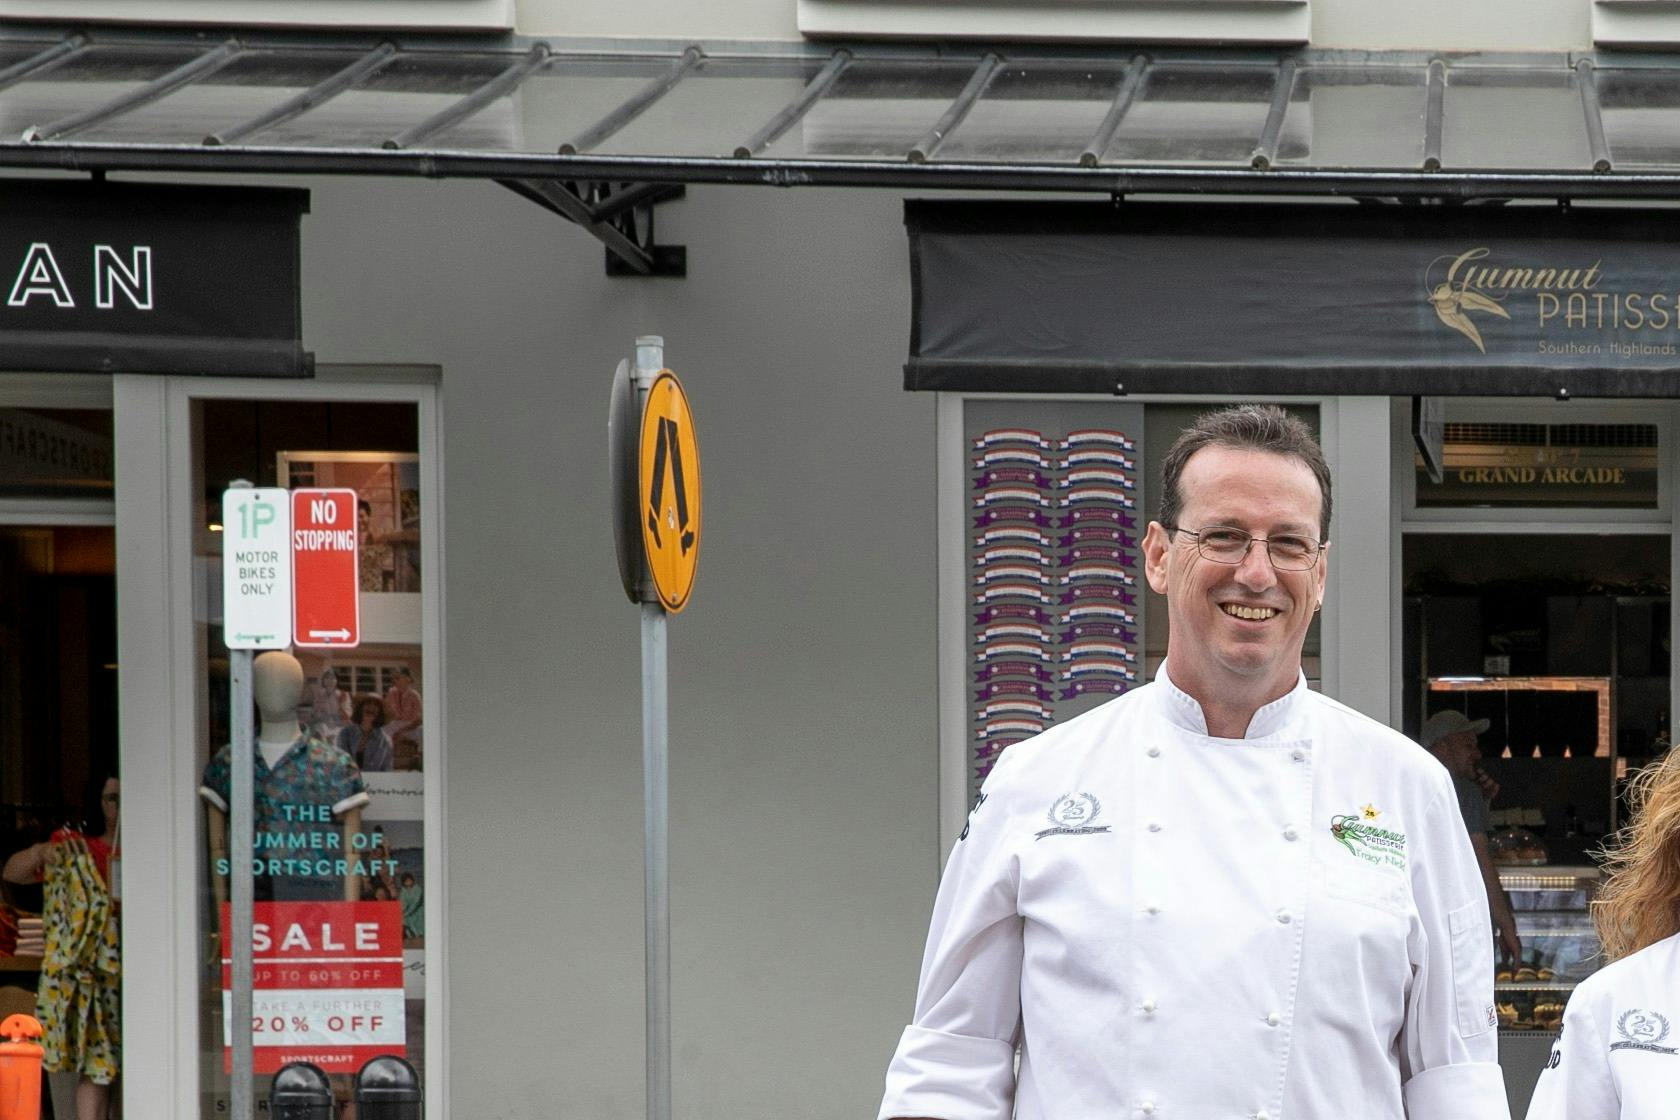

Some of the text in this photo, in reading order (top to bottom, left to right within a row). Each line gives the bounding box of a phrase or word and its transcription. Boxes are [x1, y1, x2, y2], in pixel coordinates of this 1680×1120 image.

[1446, 247, 1602, 291] Gumnut
[1538, 341, 1601, 355] Southern
[1609, 342, 1676, 357] Highlands
[1459, 467, 1626, 485] GRAND ARCADE
[237, 502, 277, 539] 1P
[311, 500, 337, 524] NO
[295, 530, 354, 551] STOPPING
[235, 551, 279, 563] MOTOR
[239, 567, 276, 579] BIKES
[240, 583, 274, 595] ONLY
[282, 804, 332, 822] THE
[1063, 799, 1085, 816] 25
[1341, 815, 1406, 845] Gumnut
[253, 832, 384, 849] UMMER OF
[216, 859, 399, 876] SORTSCRAFT
[252, 922, 381, 952] SALE
[280, 970, 300, 982] TO
[350, 969, 383, 981] OFF
[312, 1000, 383, 1012] FURTHER
[252, 1016, 384, 1033] 20% OFF
[1631, 1015, 1654, 1033] 25
[280, 1054, 354, 1064] SPORTSCRAFT
